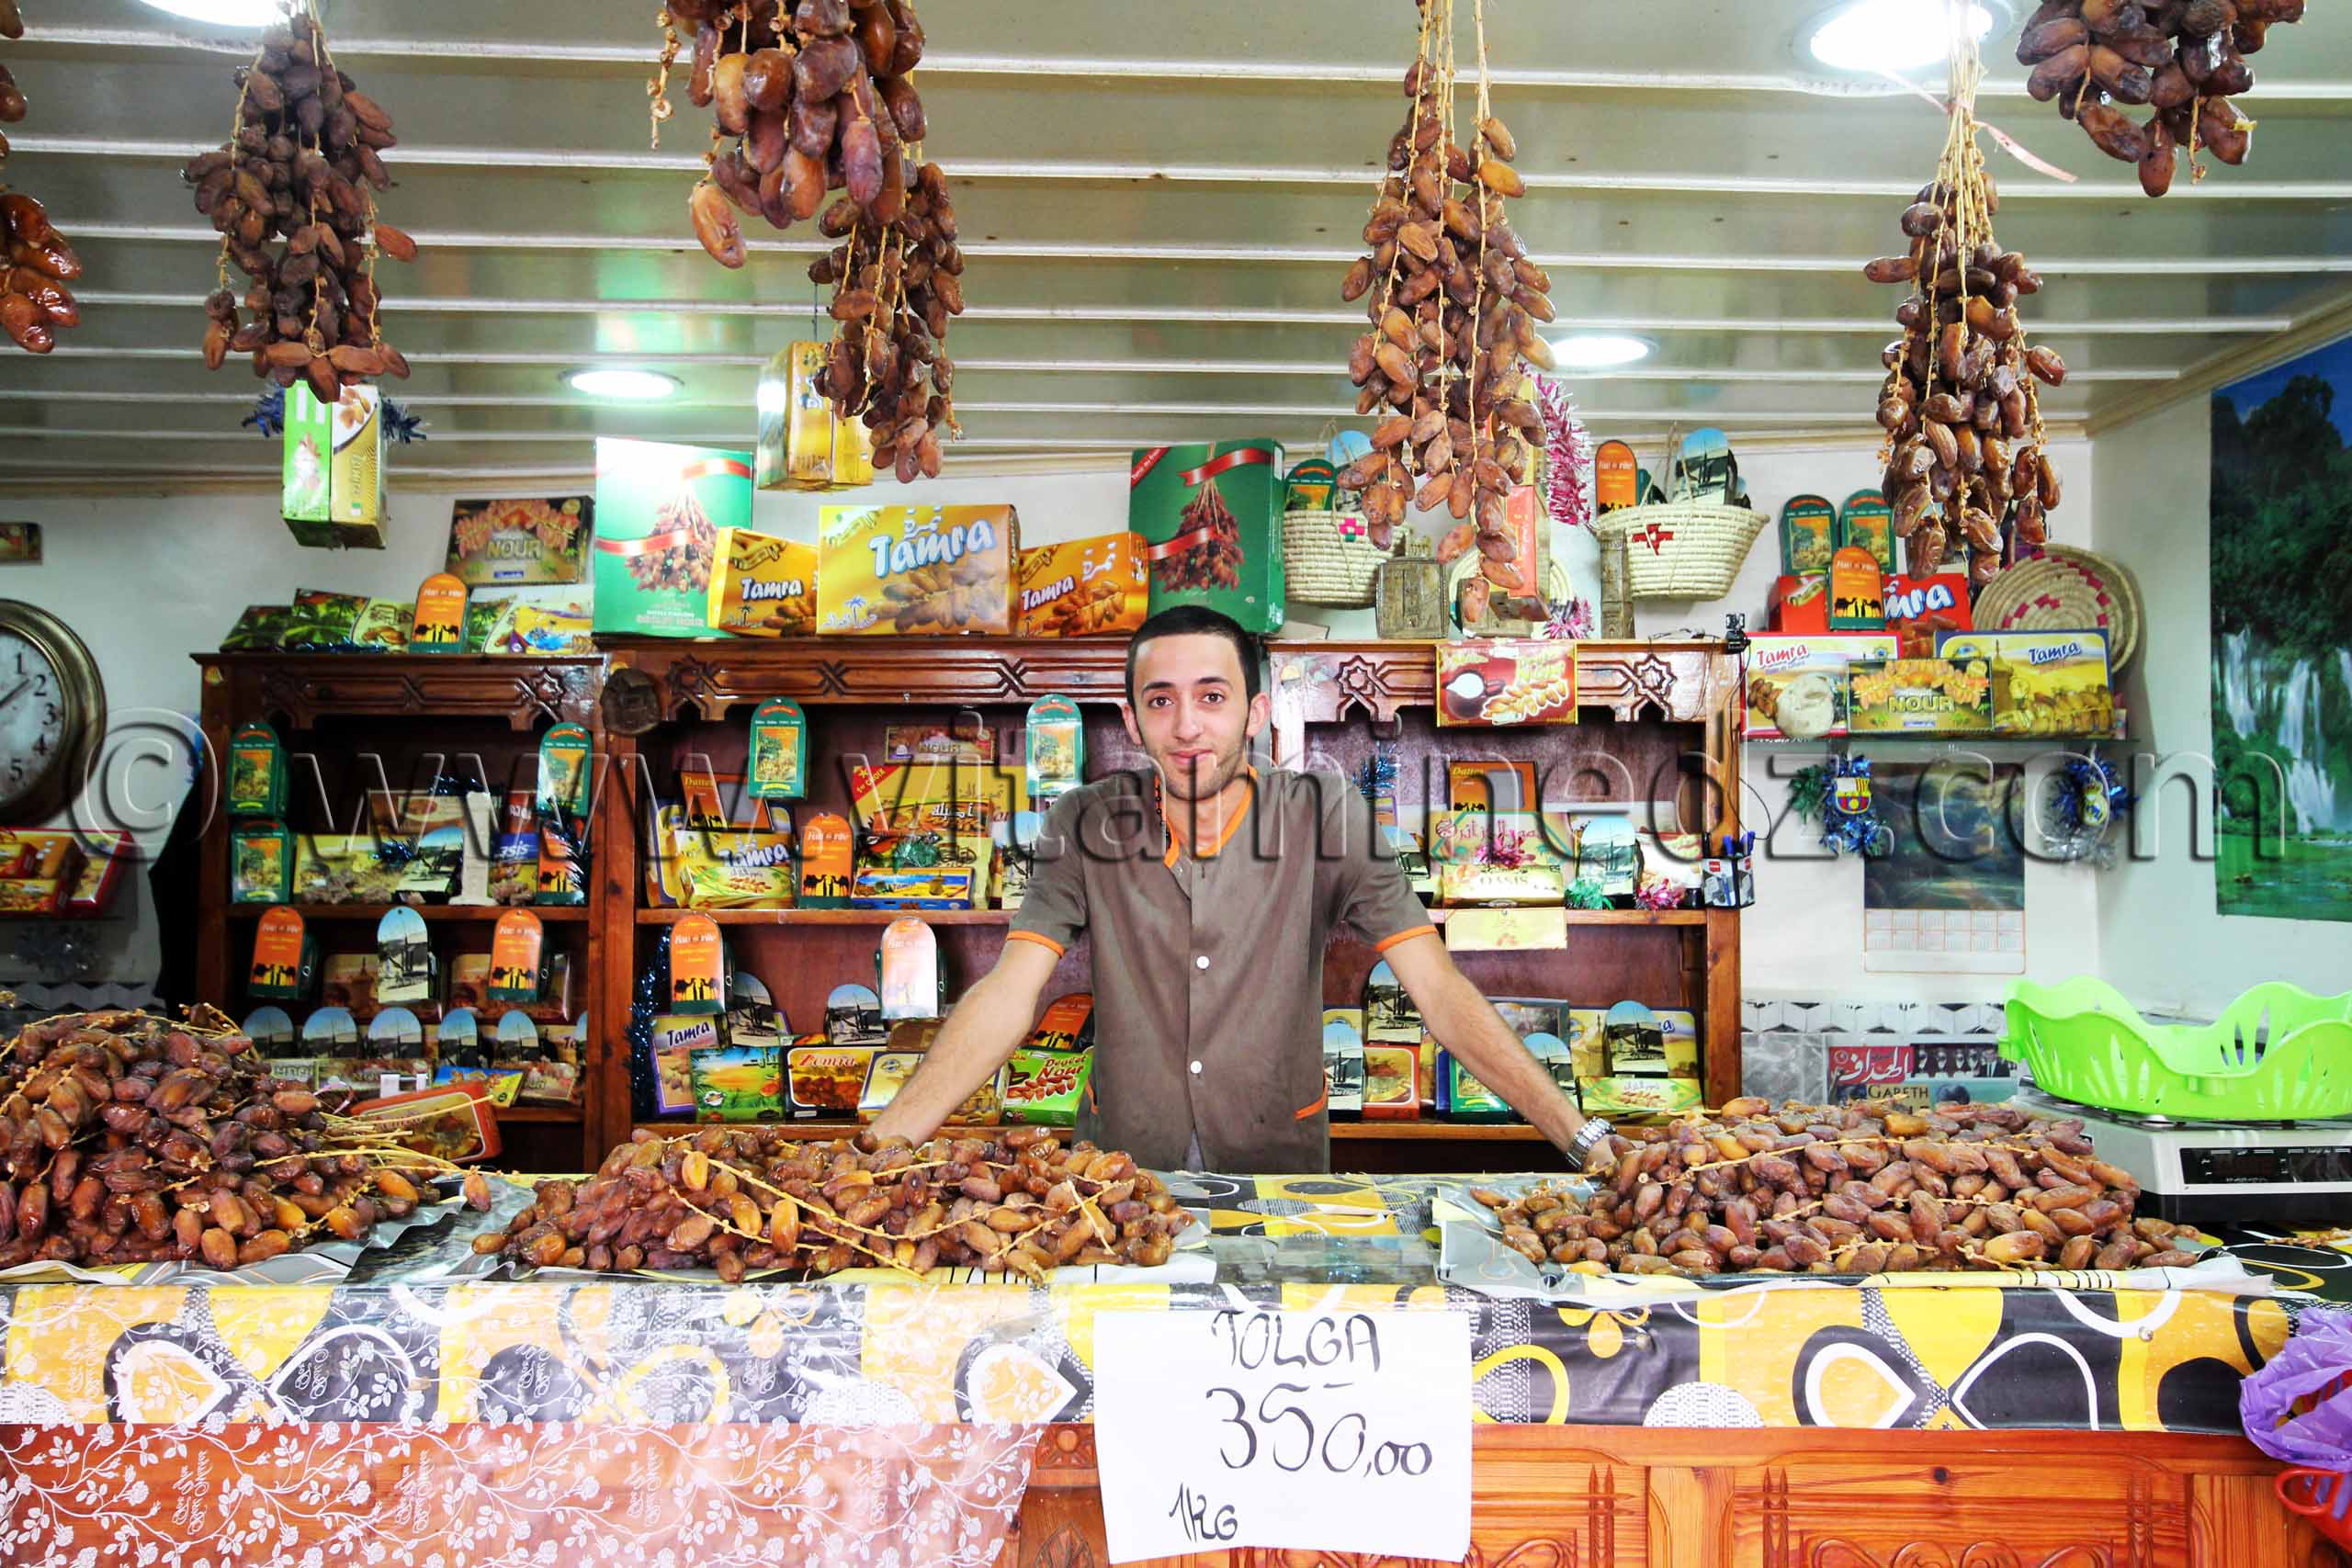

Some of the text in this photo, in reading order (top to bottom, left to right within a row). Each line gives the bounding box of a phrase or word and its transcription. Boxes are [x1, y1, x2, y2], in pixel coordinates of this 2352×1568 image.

[485, 539, 543, 560] NOUR
[868, 520, 995, 579] Tamra
[741, 577, 802, 600] Tamra
[1021, 575, 1075, 611] Tamra
[1883, 583, 1955, 621] mra
[17, 653, 26, 674] 1
[1757, 644, 1810, 667] Tamra
[2029, 640, 2083, 665] Tamra
[34, 673, 46, 696] 2
[43, 703, 57, 726] 3
[1888, 695, 1955, 714] NOUR
[32, 735, 47, 756] 4
[10, 759, 23, 781] 5
[718, 842, 790, 868] Tamra
[666, 1019, 711, 1047] Tamra
[1211, 1310, 1381, 1373] TOLGA
[1206, 1382, 1432, 1477] 350,00
